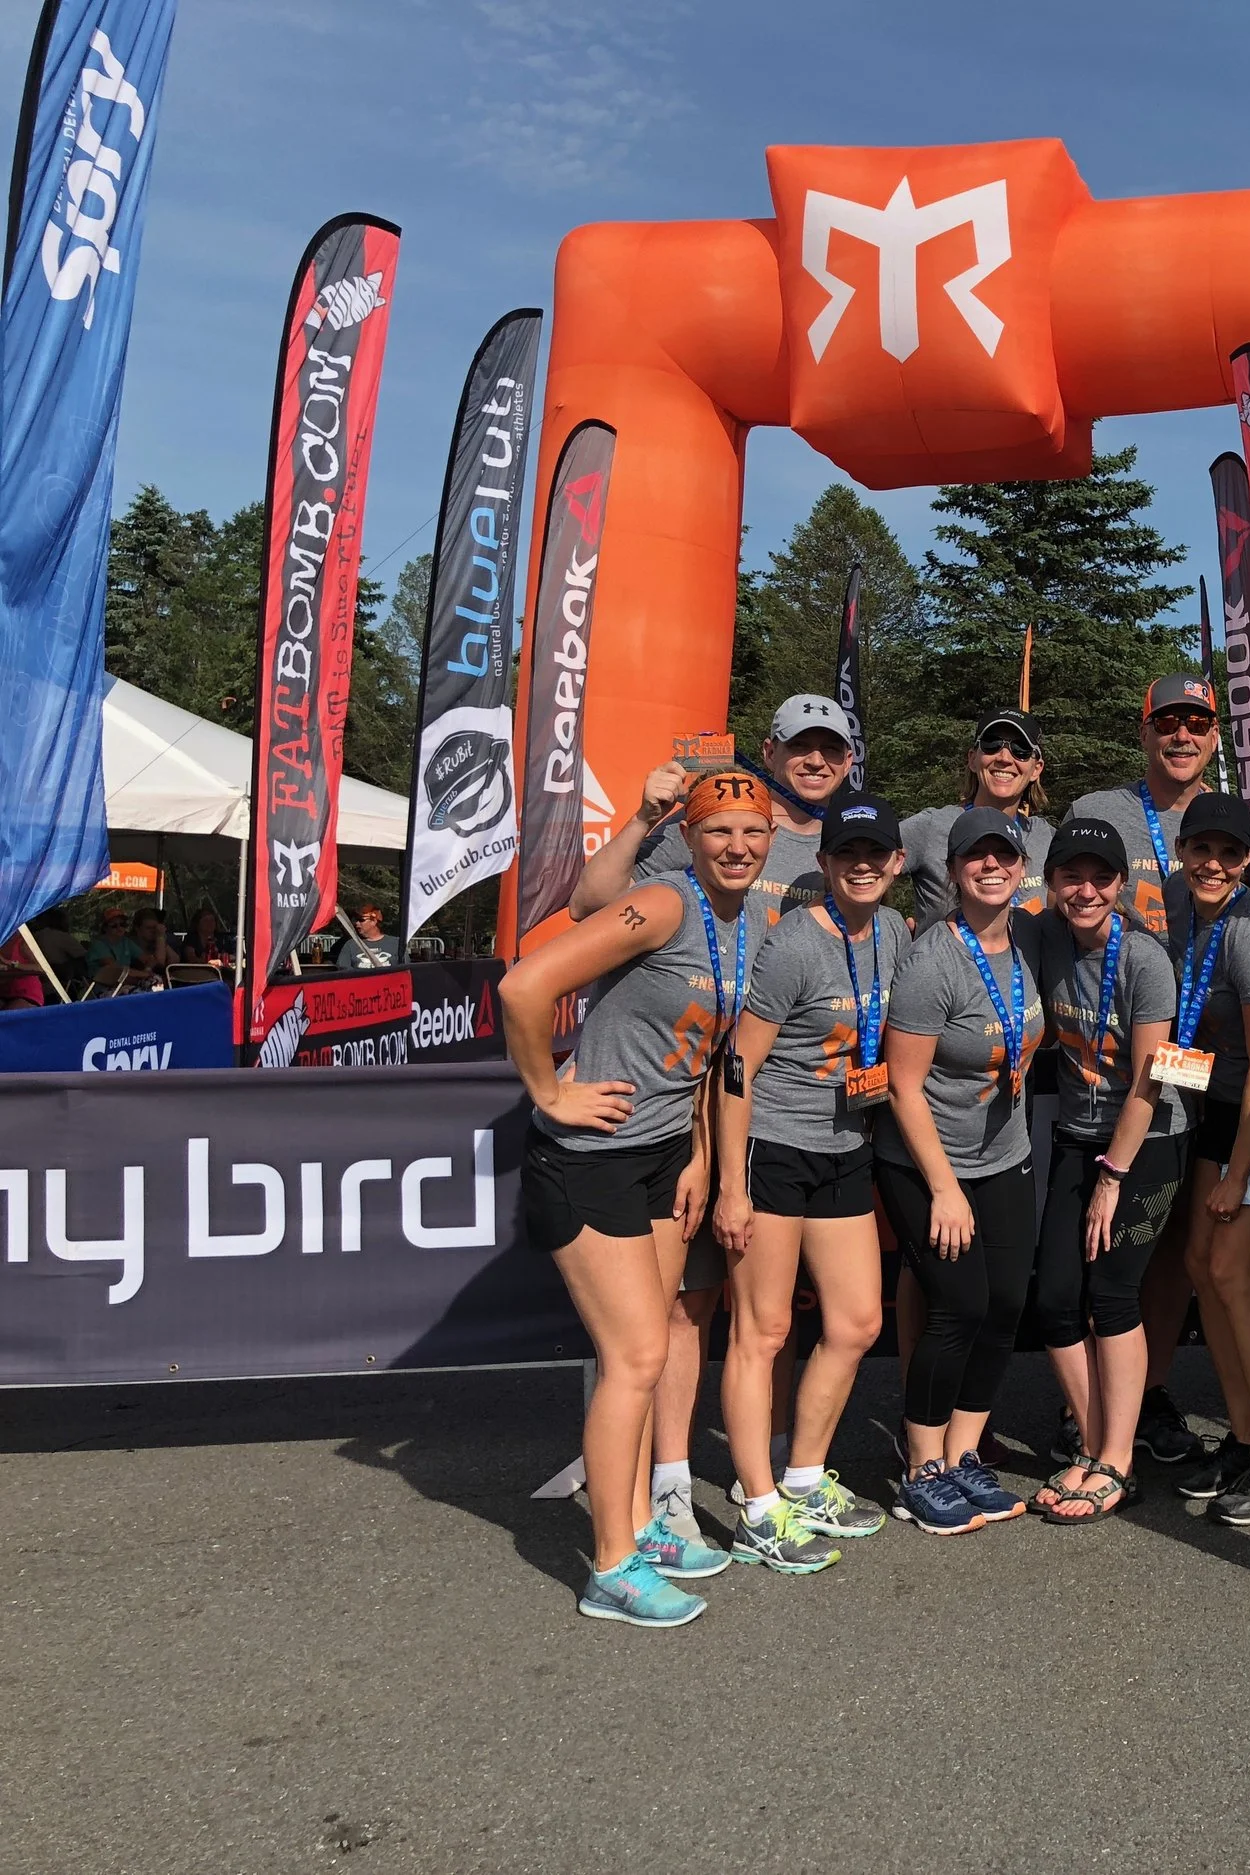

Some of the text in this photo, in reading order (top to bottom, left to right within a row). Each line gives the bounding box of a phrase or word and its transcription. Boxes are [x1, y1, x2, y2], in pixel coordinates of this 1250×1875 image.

[42, 27, 145, 330] Spry
[543, 543, 598, 793] Reebok
[1071, 828, 1108, 841] TWLV
[420, 834, 515, 896] bluerub.com
[311, 991, 336, 1024] FAT
[337, 1000, 348, 1021] is
[348, 989, 381, 1018] Smart
[411, 995, 476, 1049] Reebok
[109, 1031, 157, 1049] DENTAL DEFENSE
